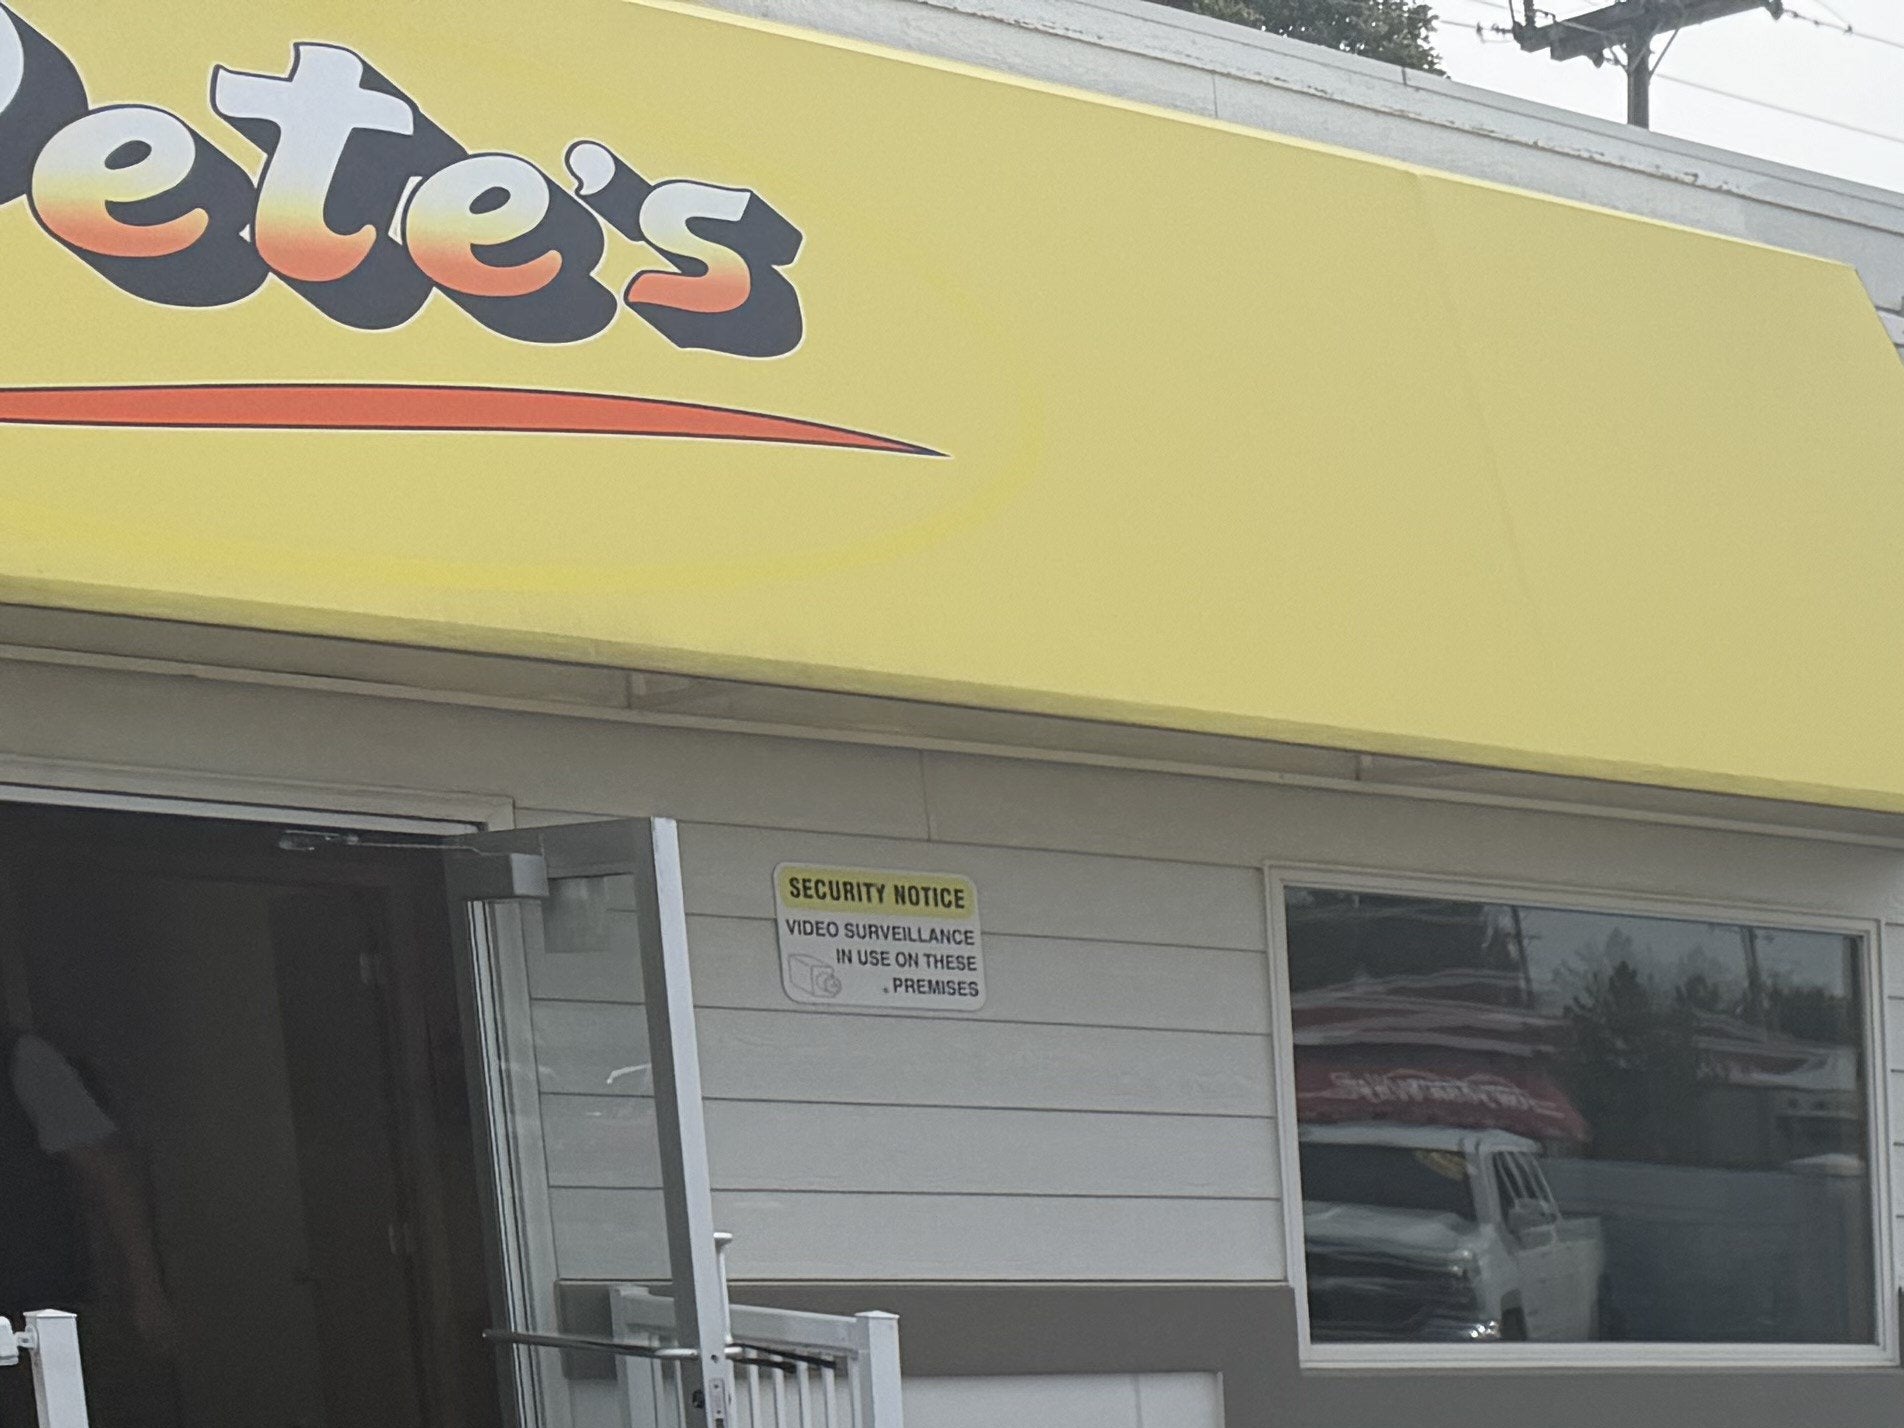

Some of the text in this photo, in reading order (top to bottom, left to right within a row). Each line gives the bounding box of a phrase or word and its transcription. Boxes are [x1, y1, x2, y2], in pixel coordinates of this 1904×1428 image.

[0, 8, 796, 354] ete's
[789, 877, 965, 909] SECURITY NOTICE
[785, 918, 975, 945] VIDEO SURVEILLANCE
[836, 948, 977, 971] IN USE ON THESE
[892, 977, 979, 998] PREMISES
